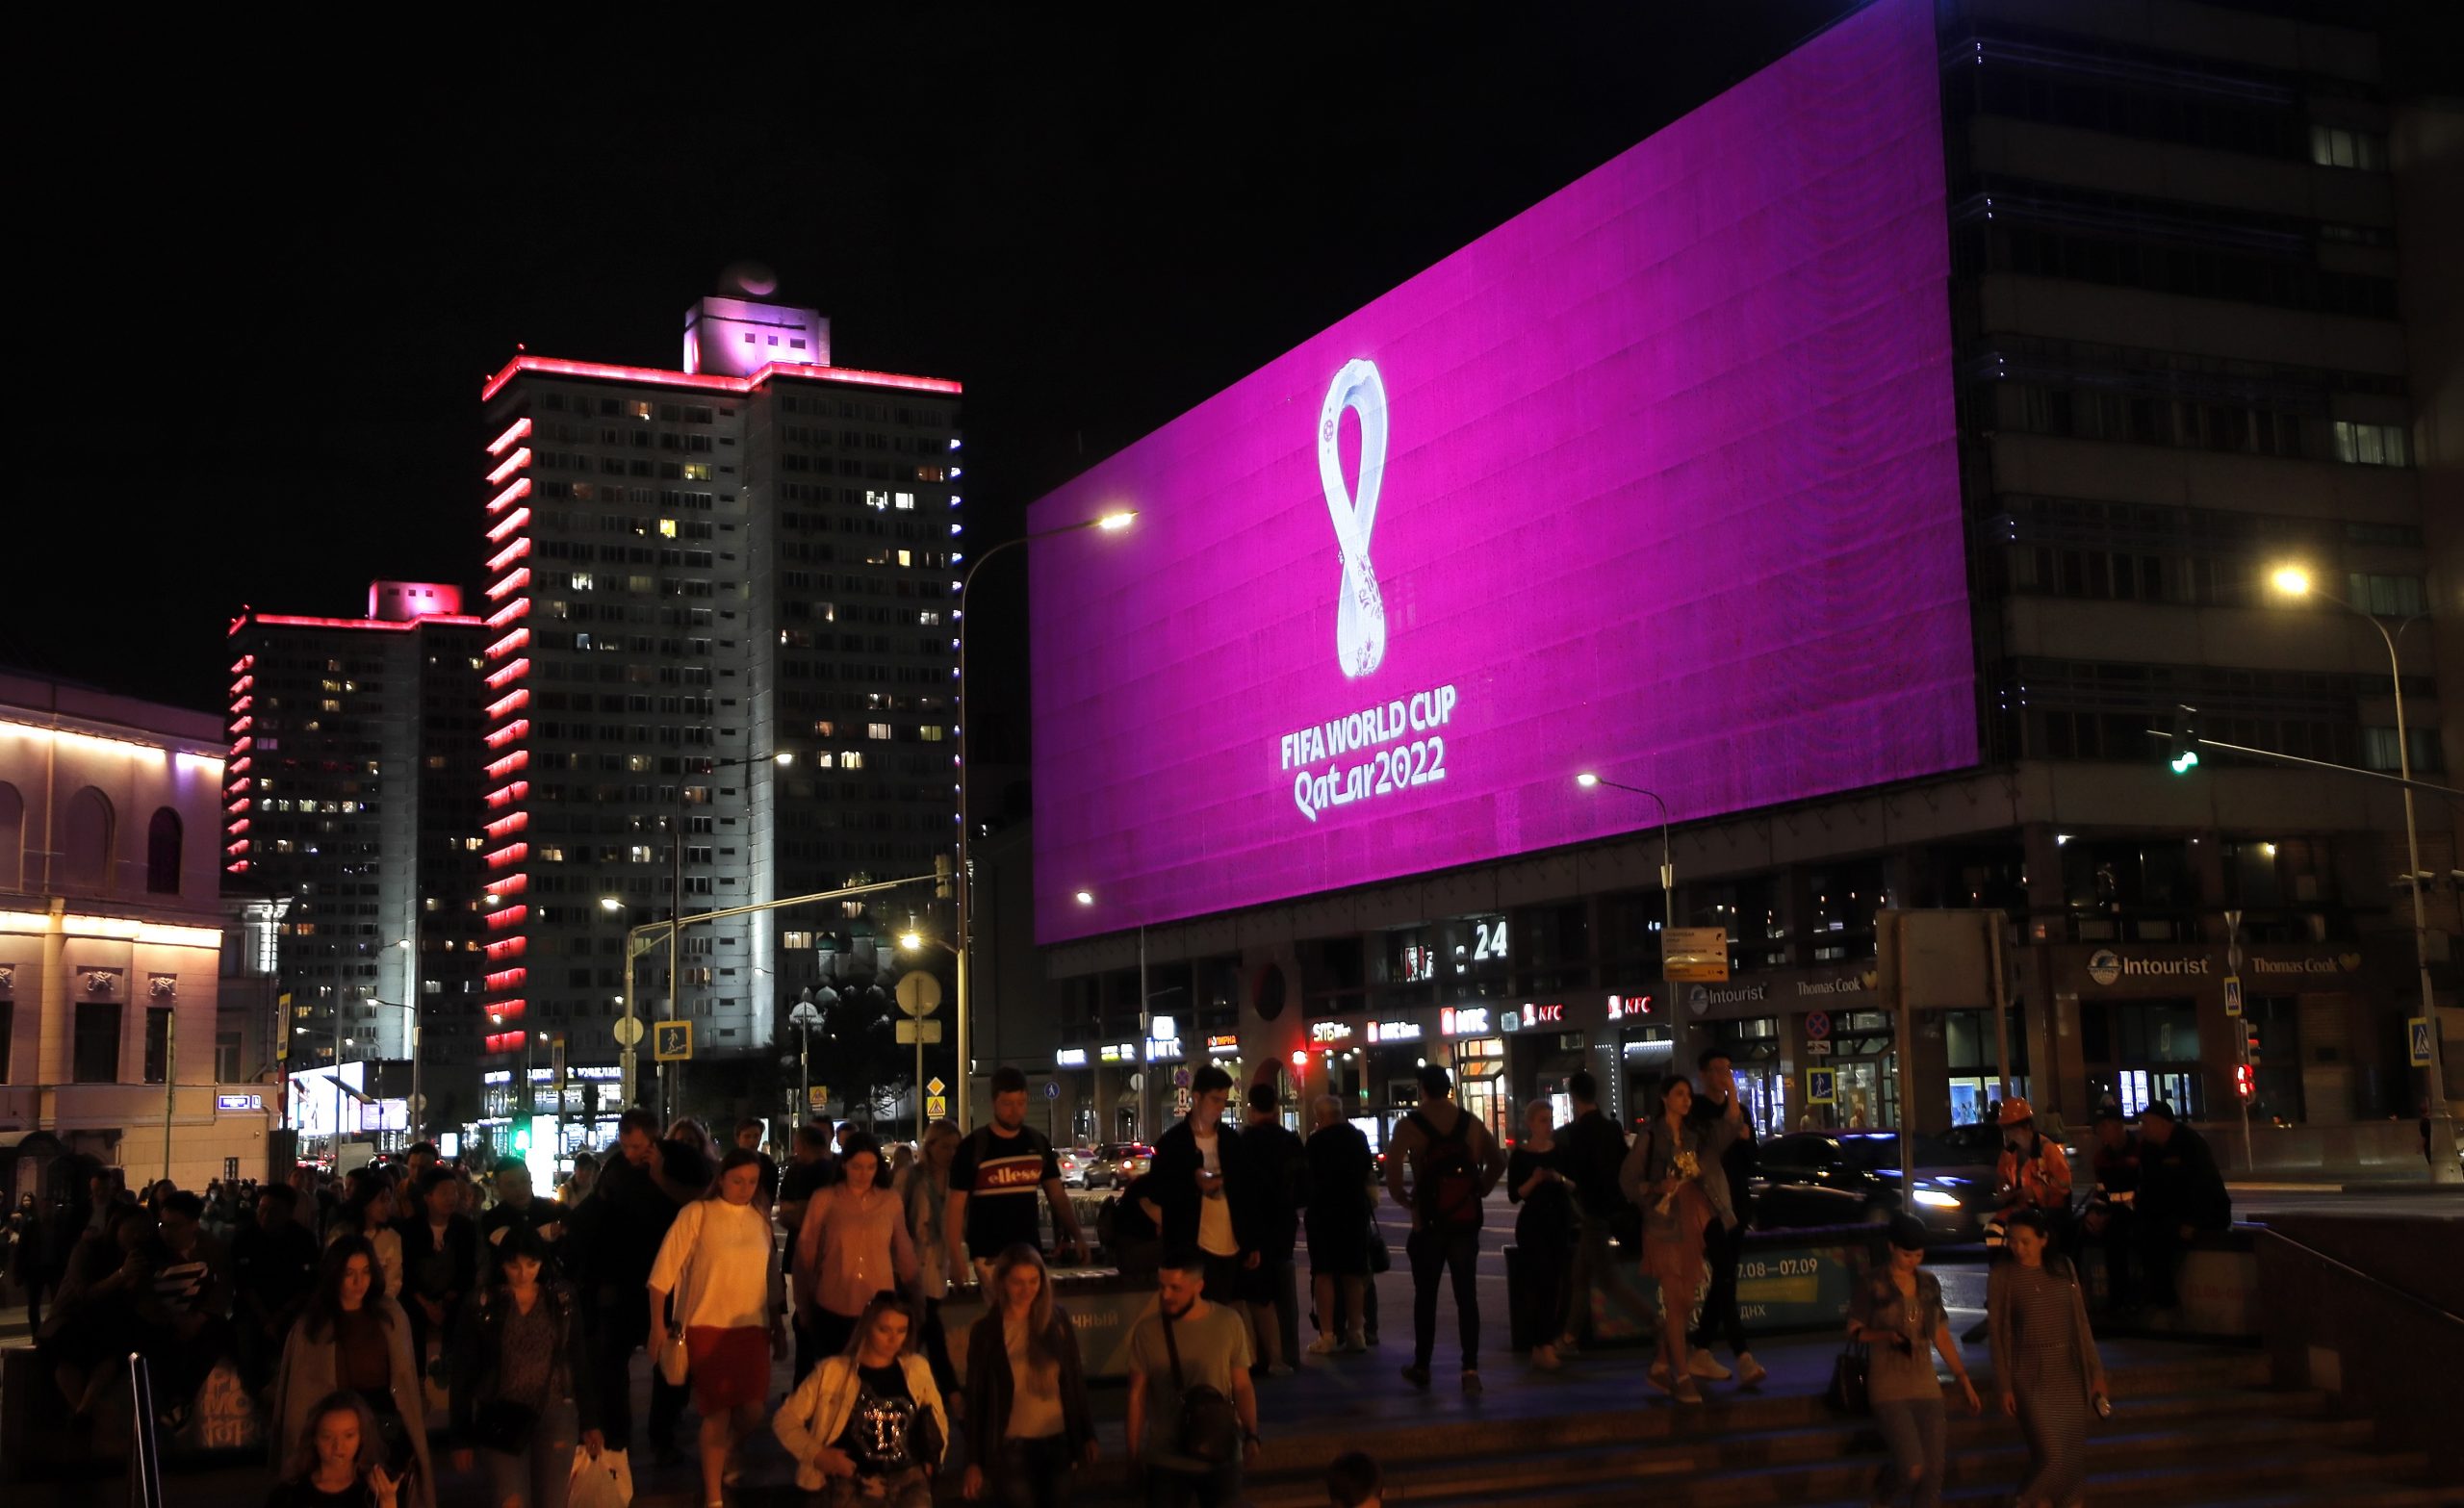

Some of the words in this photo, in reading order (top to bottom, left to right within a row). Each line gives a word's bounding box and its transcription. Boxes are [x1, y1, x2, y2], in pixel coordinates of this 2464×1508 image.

[1281, 726, 1325, 770] FIFA
[1326, 701, 1406, 756] WORLD
[1410, 684, 1455, 731] CUP
[1475, 921, 1506, 960] 24
[2123, 956, 2209, 975] Intourist
[2251, 957, 2304, 974] Thomas
[2305, 957, 2338, 974] Cook
[1709, 984, 1765, 1005] Intourist
[1797, 979, 1835, 996] Thomas
[1836, 976, 1861, 992] Cook
[1539, 1004, 1564, 1022] KFC
[1626, 996, 1652, 1015] KFC
[1739, 1304, 1766, 1321] ДНХ
